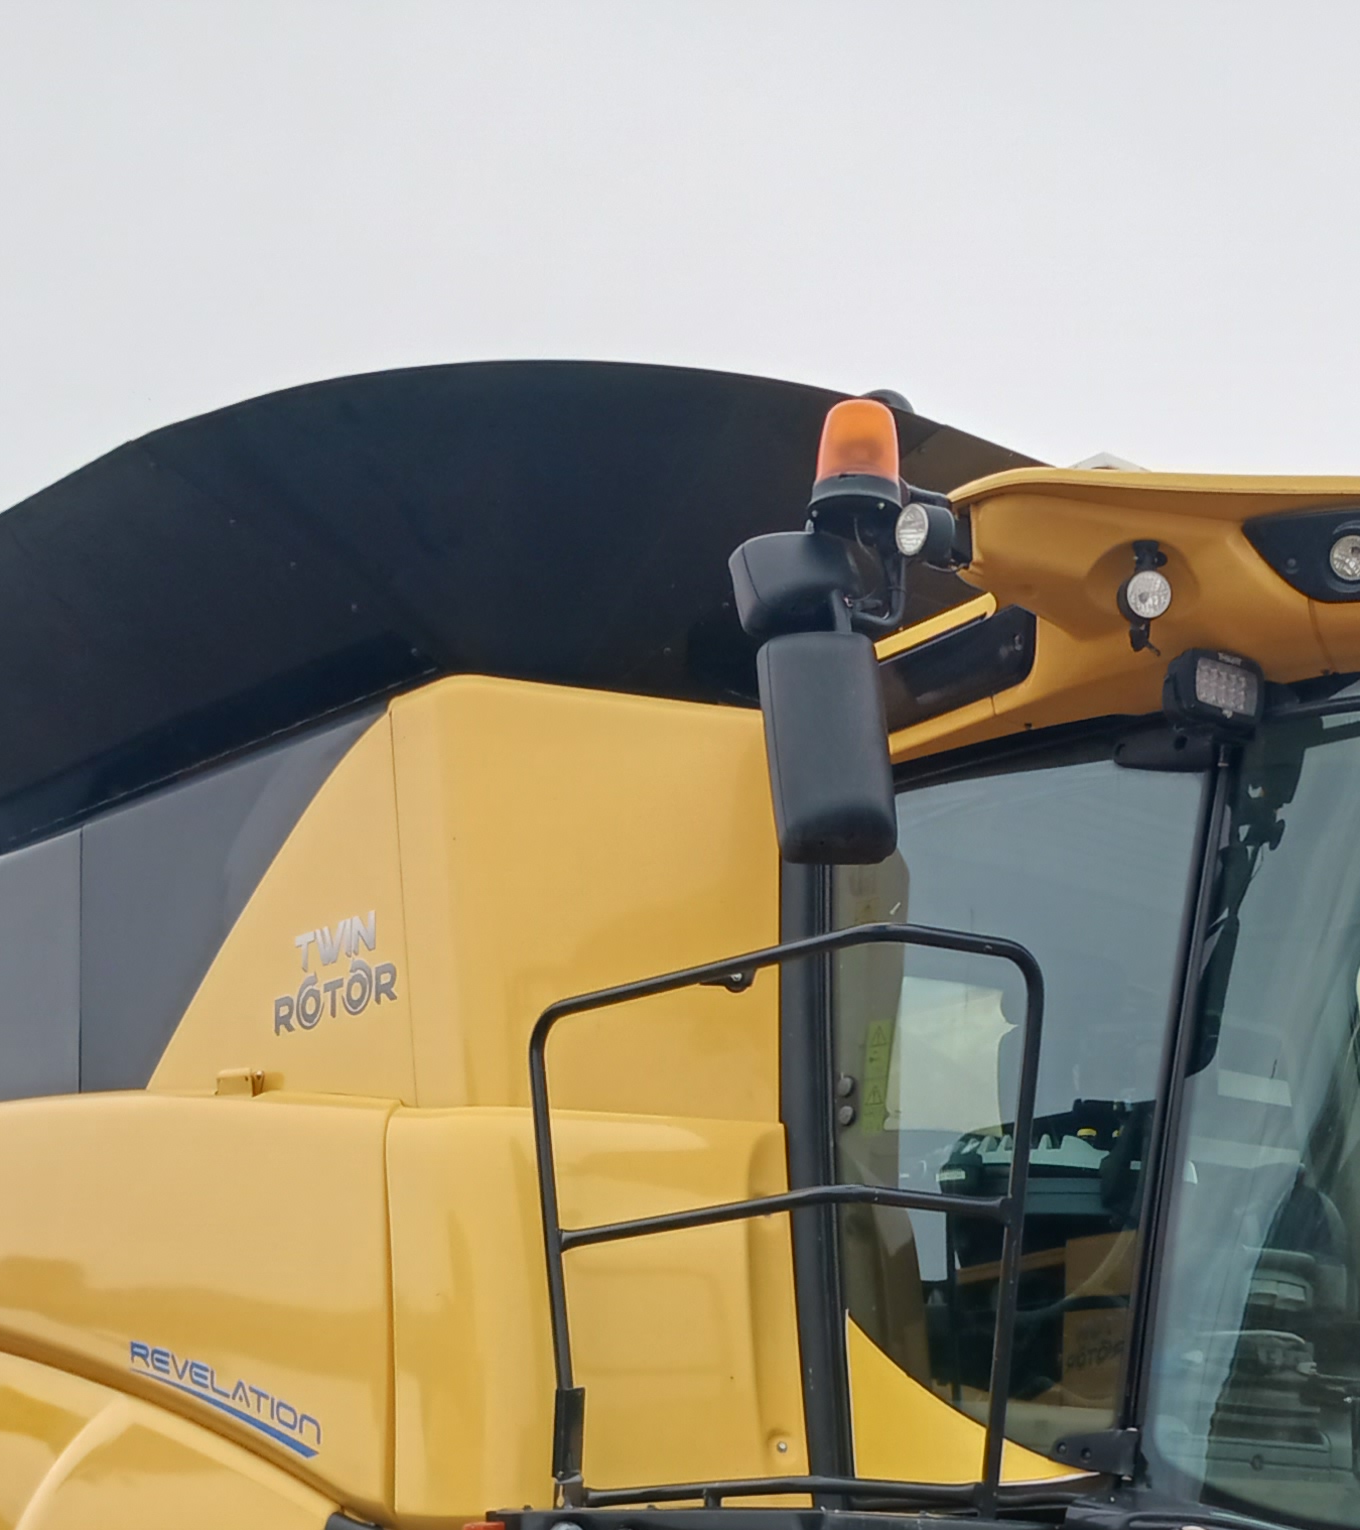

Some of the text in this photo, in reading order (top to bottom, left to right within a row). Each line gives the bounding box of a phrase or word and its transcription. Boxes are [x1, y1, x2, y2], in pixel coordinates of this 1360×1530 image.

[295, 910, 377, 973] TWIN
[274, 957, 398, 1037] ROTOR
[129, 1340, 322, 1446] REVELATION
